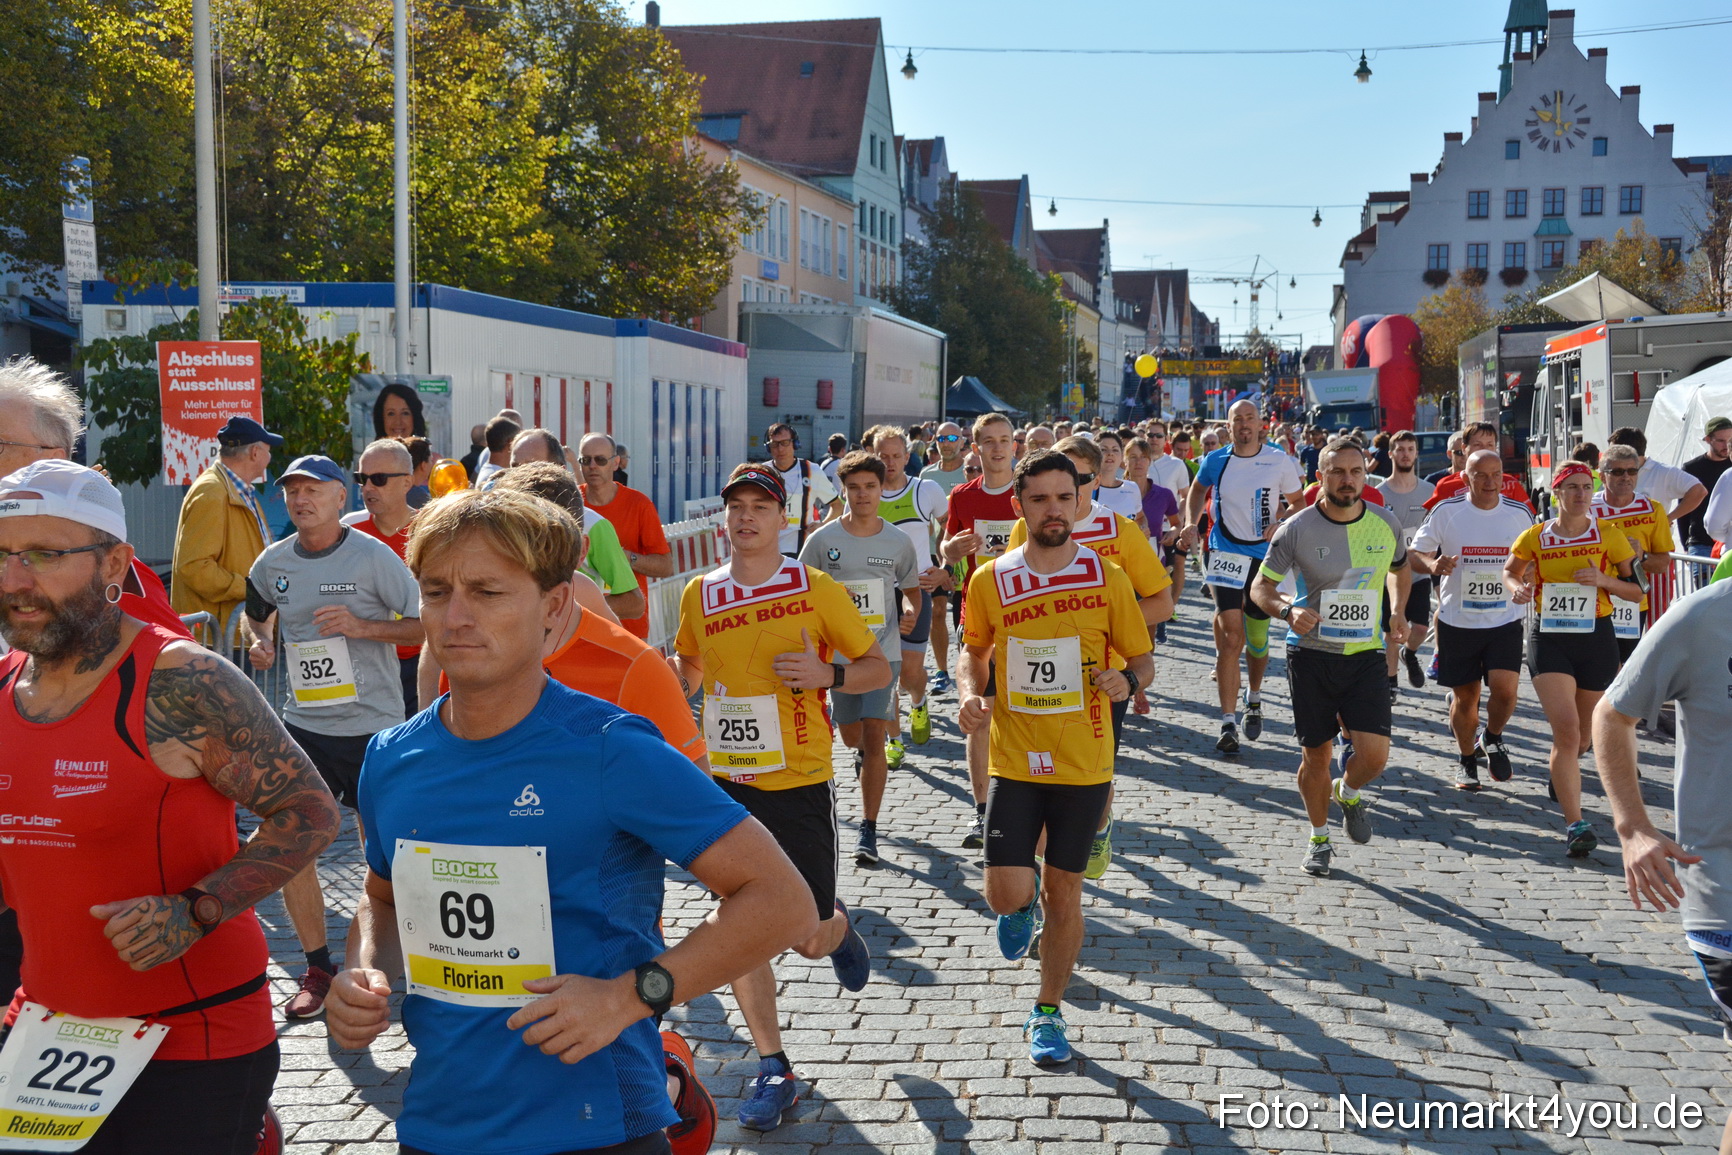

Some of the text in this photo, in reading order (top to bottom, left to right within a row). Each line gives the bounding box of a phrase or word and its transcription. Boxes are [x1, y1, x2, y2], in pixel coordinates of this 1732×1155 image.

[168, 351, 255, 367] Abschluss
[168, 368, 197, 377] statt
[169, 378, 256, 391] Ausschluss!
[184, 399, 252, 409] Mehr Lehrer für
[181, 410, 218, 420] kleinere
[1624, 516, 1656, 528] BÖGL
[868, 557, 895, 566] BOCK
[1541, 547, 1602, 561] MAX BÖGL
[1213, 559, 1243, 575] 2494
[320, 583, 358, 593] BOCK
[1468, 582, 1503, 596] 2196
[1549, 596, 1588, 611] 2417
[705, 600, 814, 638] MAX BÖGL
[1003, 594, 1107, 629] MAX BÖGL
[1328, 604, 1370, 621] 2888
[1023, 646, 1057, 656] BOCK
[300, 658, 337, 681] 352
[1027, 661, 1056, 684] 79
[720, 703, 753, 713] BOCK
[1025, 696, 1062, 707] Mathias
[718, 718, 760, 742] 255
[55, 757, 109, 772] HEINLOTH
[728, 755, 757, 766] Simon
[509, 807, 545, 817] odlo
[1, 814, 62, 827] Gruber
[30, 840, 77, 848] BADGESTALTER
[432, 858, 500, 880] BOCK
[440, 890, 495, 942] 69
[429, 943, 504, 959] PARTL Neumarkt
[443, 966, 504, 990] Florian
[58, 1022, 123, 1044] BOCK
[27, 1047, 116, 1097] 222
[16, 1095, 89, 1111] PARTL Neumarkt
[7, 1115, 84, 1137] Reinhard
